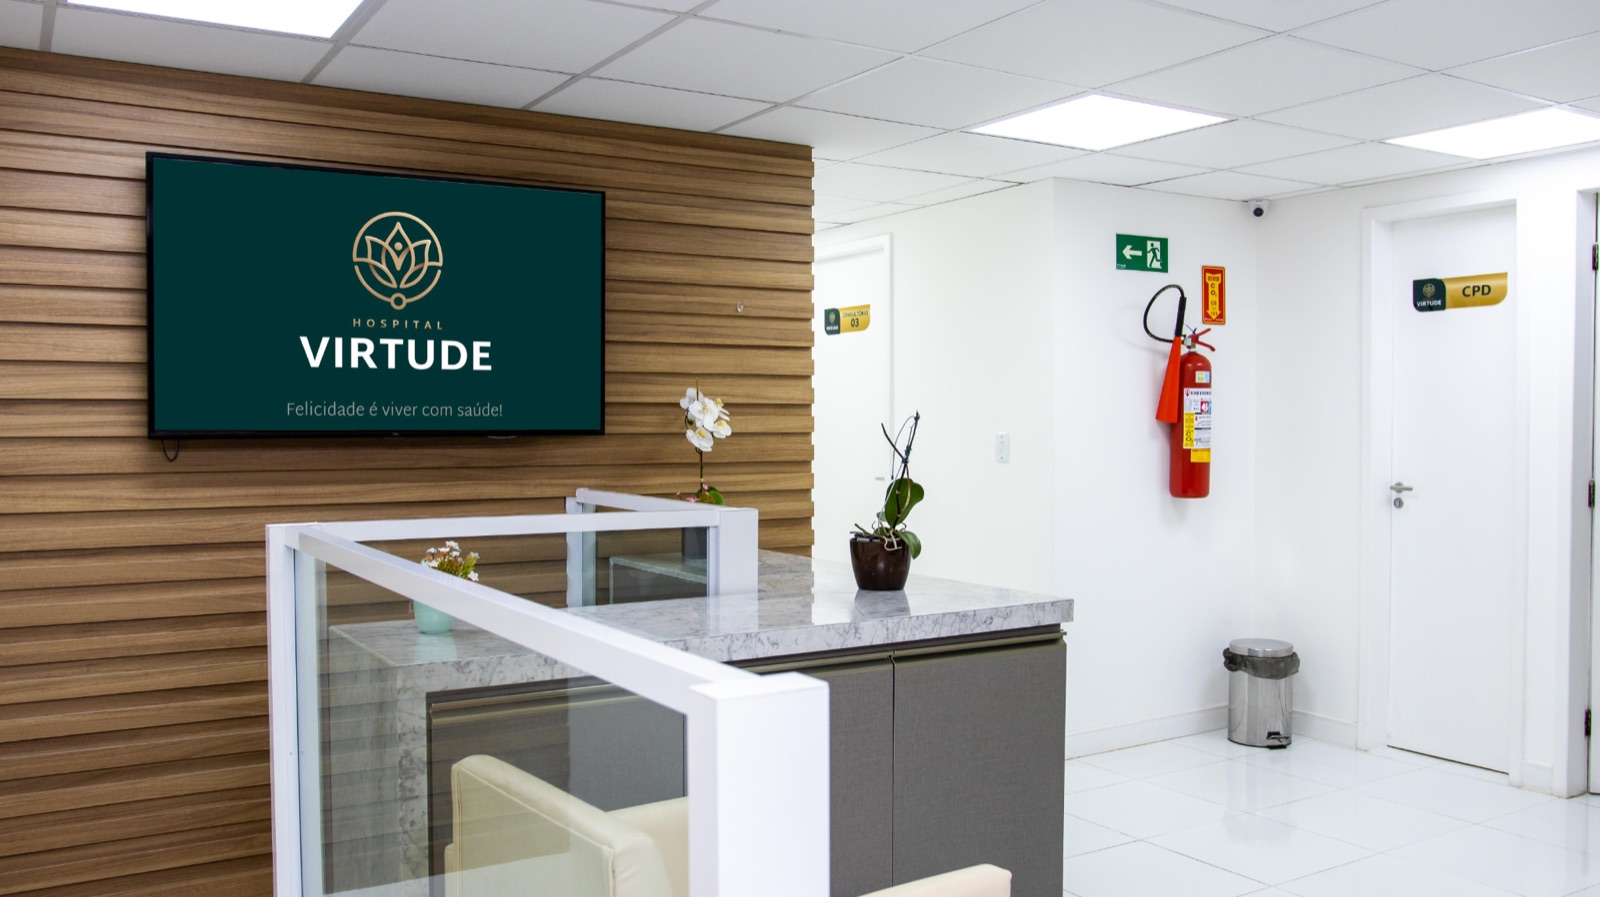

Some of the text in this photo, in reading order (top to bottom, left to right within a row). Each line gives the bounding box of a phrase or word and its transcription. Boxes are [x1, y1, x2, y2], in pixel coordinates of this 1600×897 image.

[1462, 284, 1491, 297] CPD
[1416, 299, 1442, 307] VIRTUDE
[352, 318, 443, 330] HOSPITAL
[851, 318, 859, 327] 03
[299, 335, 493, 371] VIRTUDE
[286, 401, 503, 417] Felicidade é viver com saúde!
